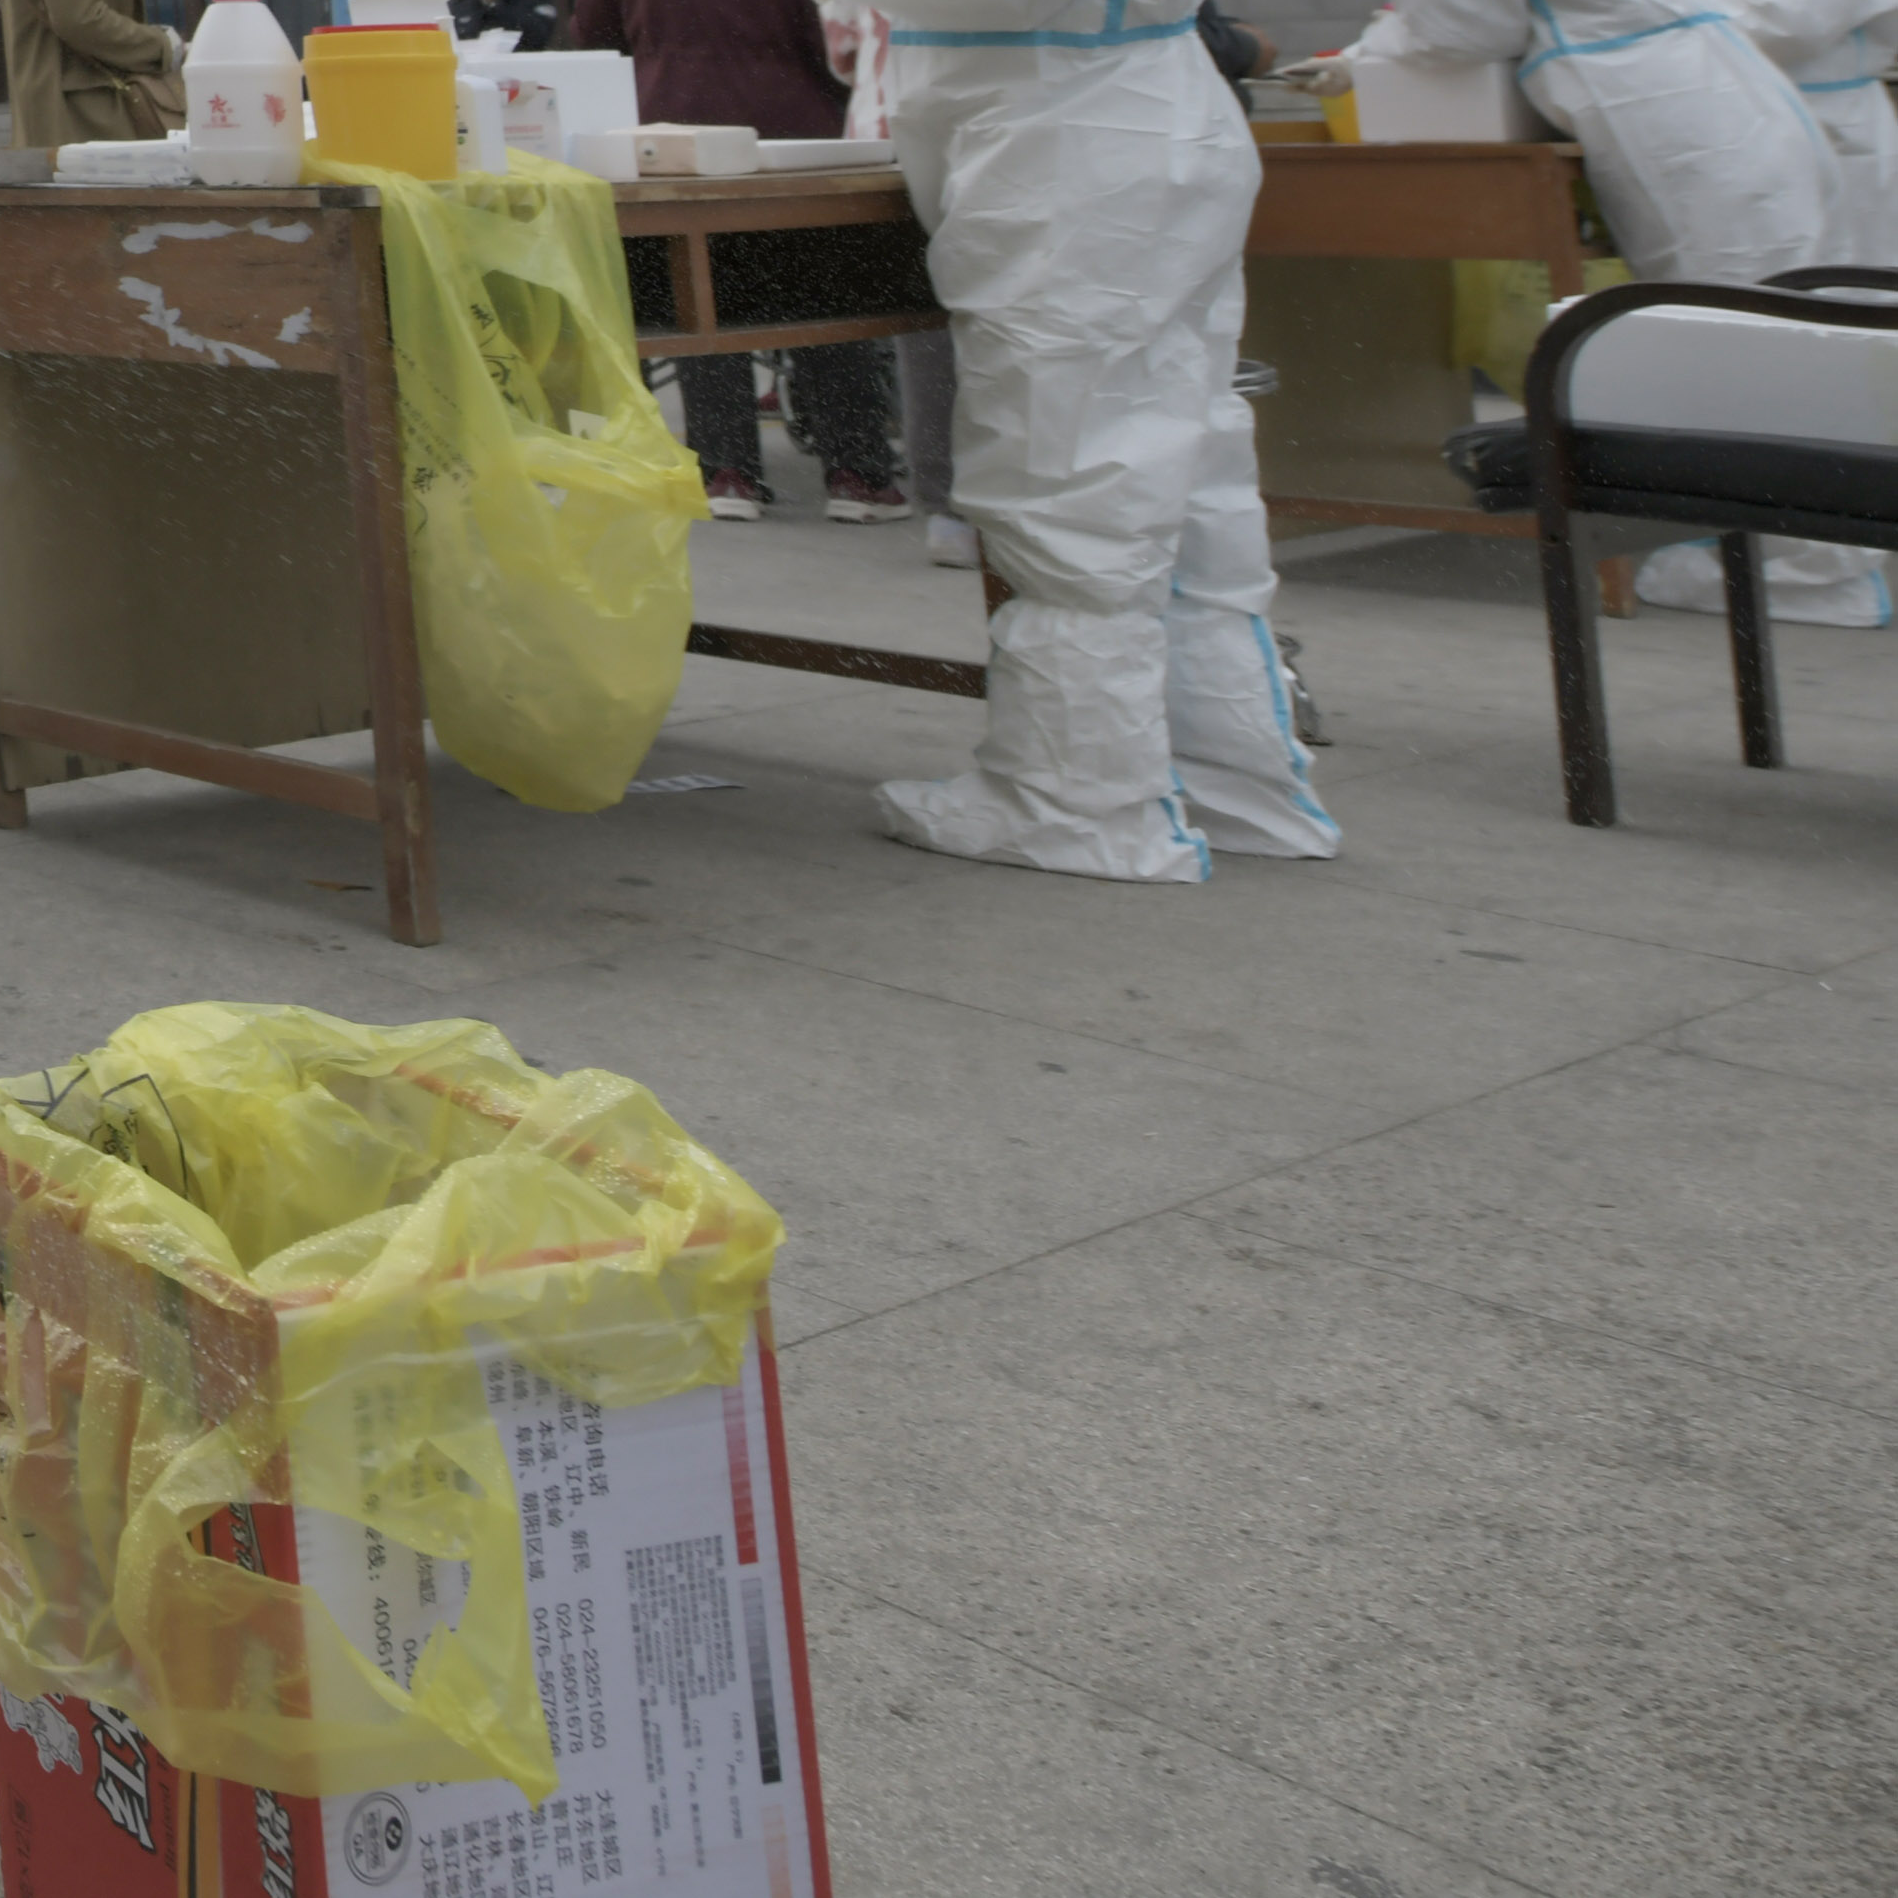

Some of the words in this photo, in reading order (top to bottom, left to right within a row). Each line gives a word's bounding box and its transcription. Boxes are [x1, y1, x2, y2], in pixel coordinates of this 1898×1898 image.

[554, 1602, 585, 1754] 024-58061678
[577, 1597, 607, 1749] 024-23251050
[572, 1792, 600, 1886] 丹东地区
[595, 1788, 623, 1881] 大连城区
